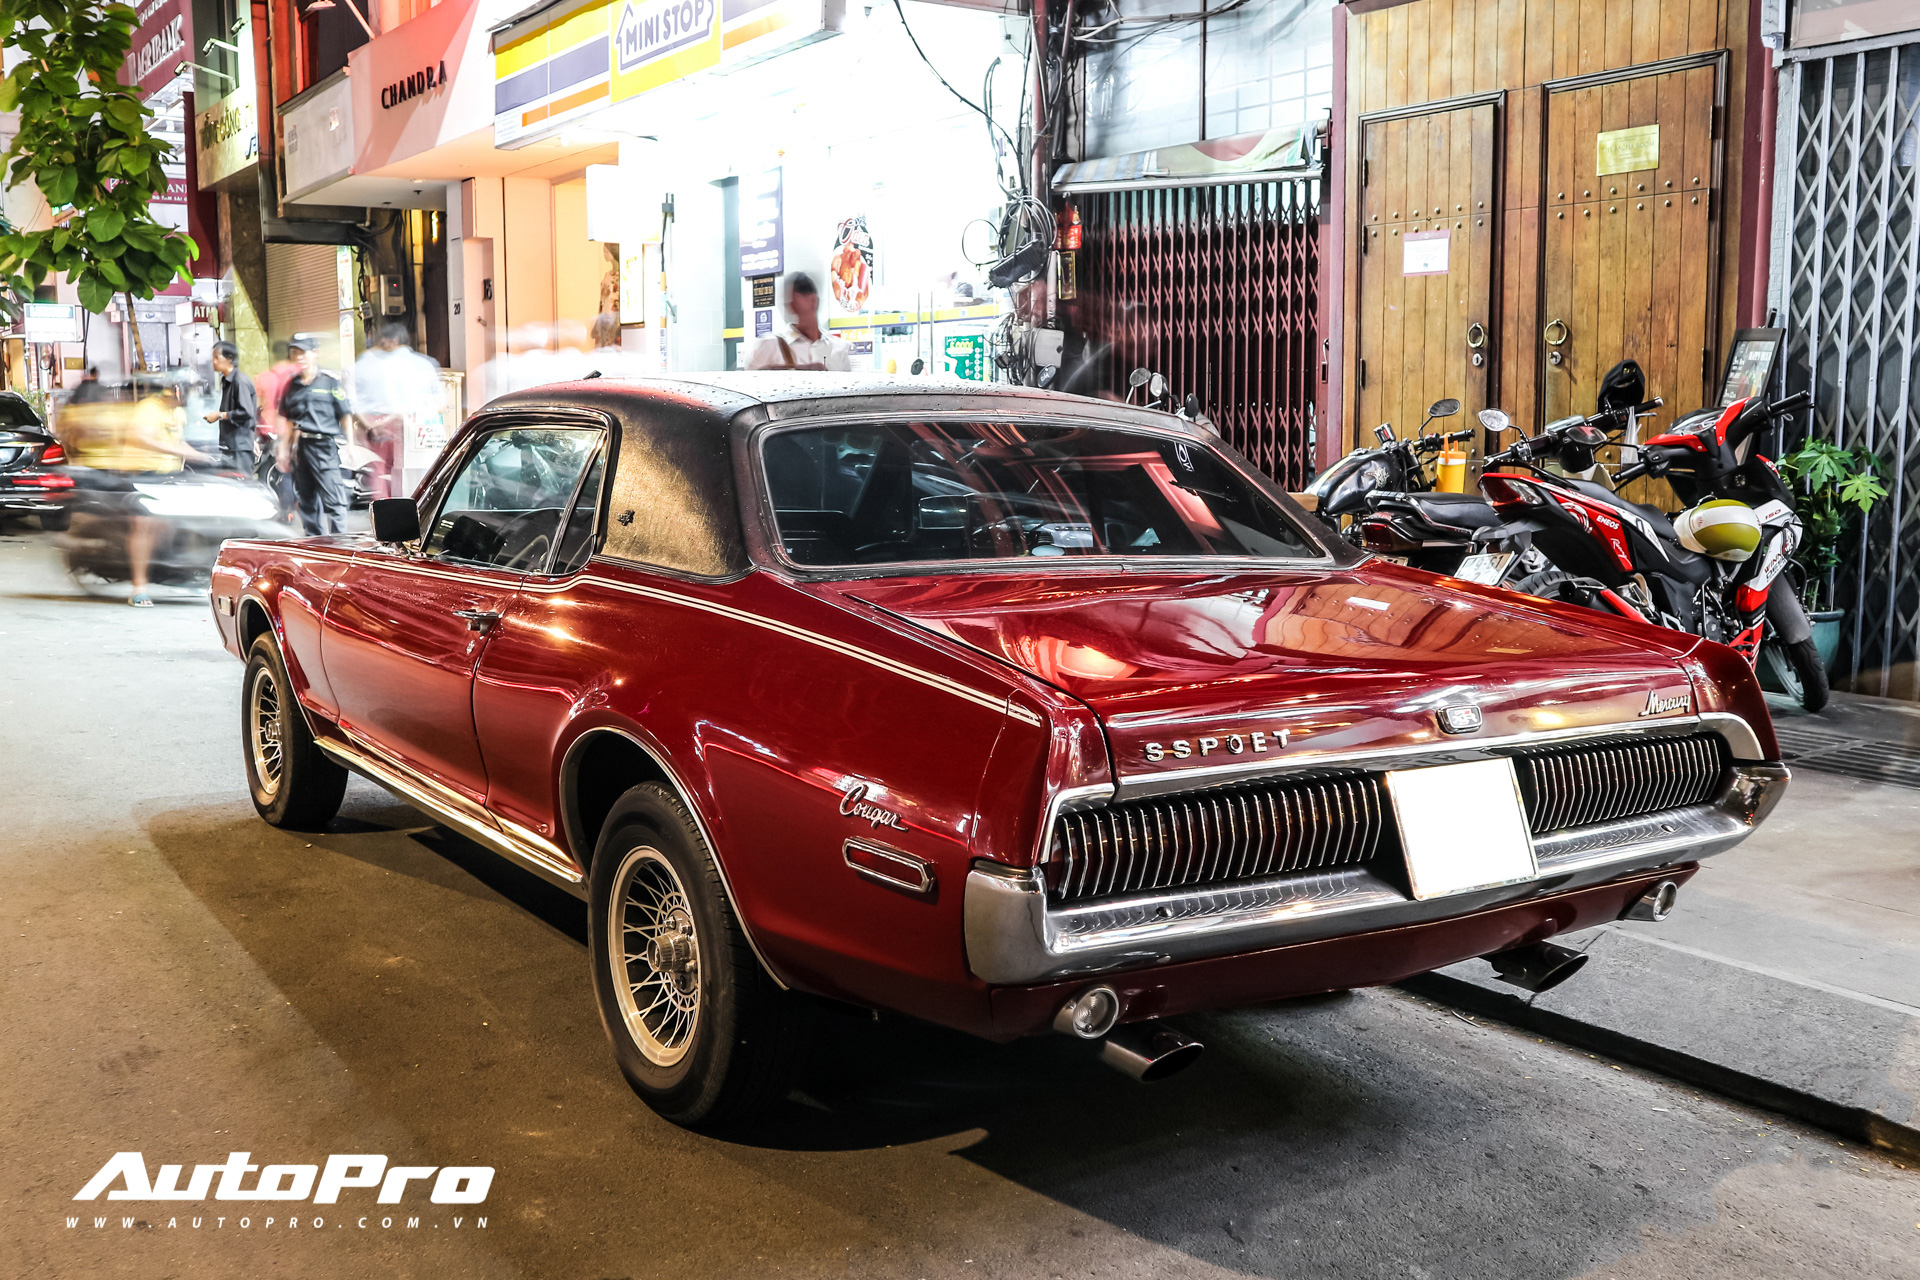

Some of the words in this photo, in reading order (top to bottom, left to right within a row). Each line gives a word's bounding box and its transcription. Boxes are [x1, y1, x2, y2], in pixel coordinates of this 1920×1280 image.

[381, 60, 447, 109] CHANDRA
[453, 302, 462, 316] 20
[1596, 514, 1620, 530] ENEOS
[1638, 690, 1692, 717] Mercury
[1145, 729, 1291, 762] SSPOET
[840, 784, 909, 831] Cougar
